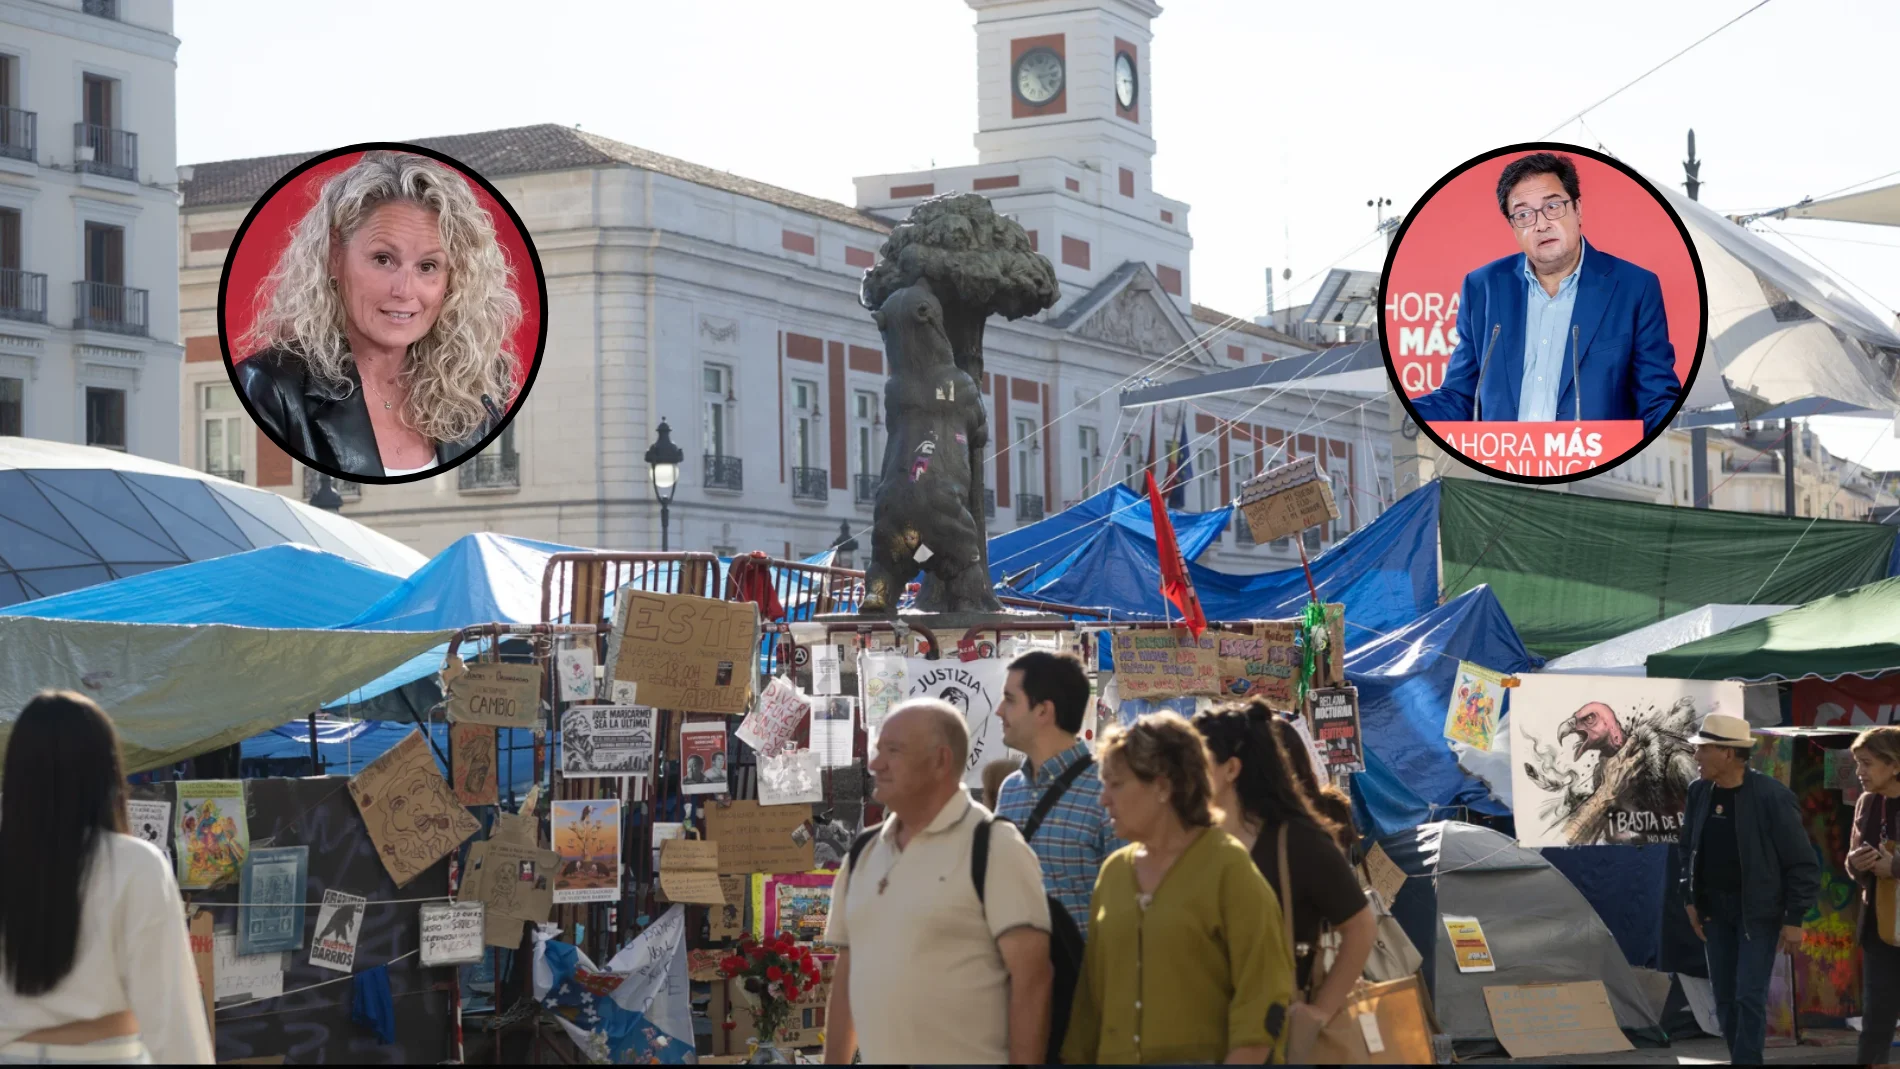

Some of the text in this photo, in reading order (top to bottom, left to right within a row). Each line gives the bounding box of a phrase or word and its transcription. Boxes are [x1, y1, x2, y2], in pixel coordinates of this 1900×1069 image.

[1445, 427, 1602, 457] AHORA MÁS
[624, 596, 753, 650] ESTE
[917, 668, 981, 694] JUSTIZIA
[469, 694, 516, 718] CAMBIO
[678, 687, 745, 708] APPLE
[1315, 705, 1353, 719] NOCTURNA
[594, 719, 608, 730] SEA
[610, 719, 619, 728] LA
[1608, 811, 1659, 837] ¡BASTA
[1661, 815, 1677, 830] DE
[1647, 833, 1679, 843] NO MÁS
[311, 946, 353, 967] BARRIOS
